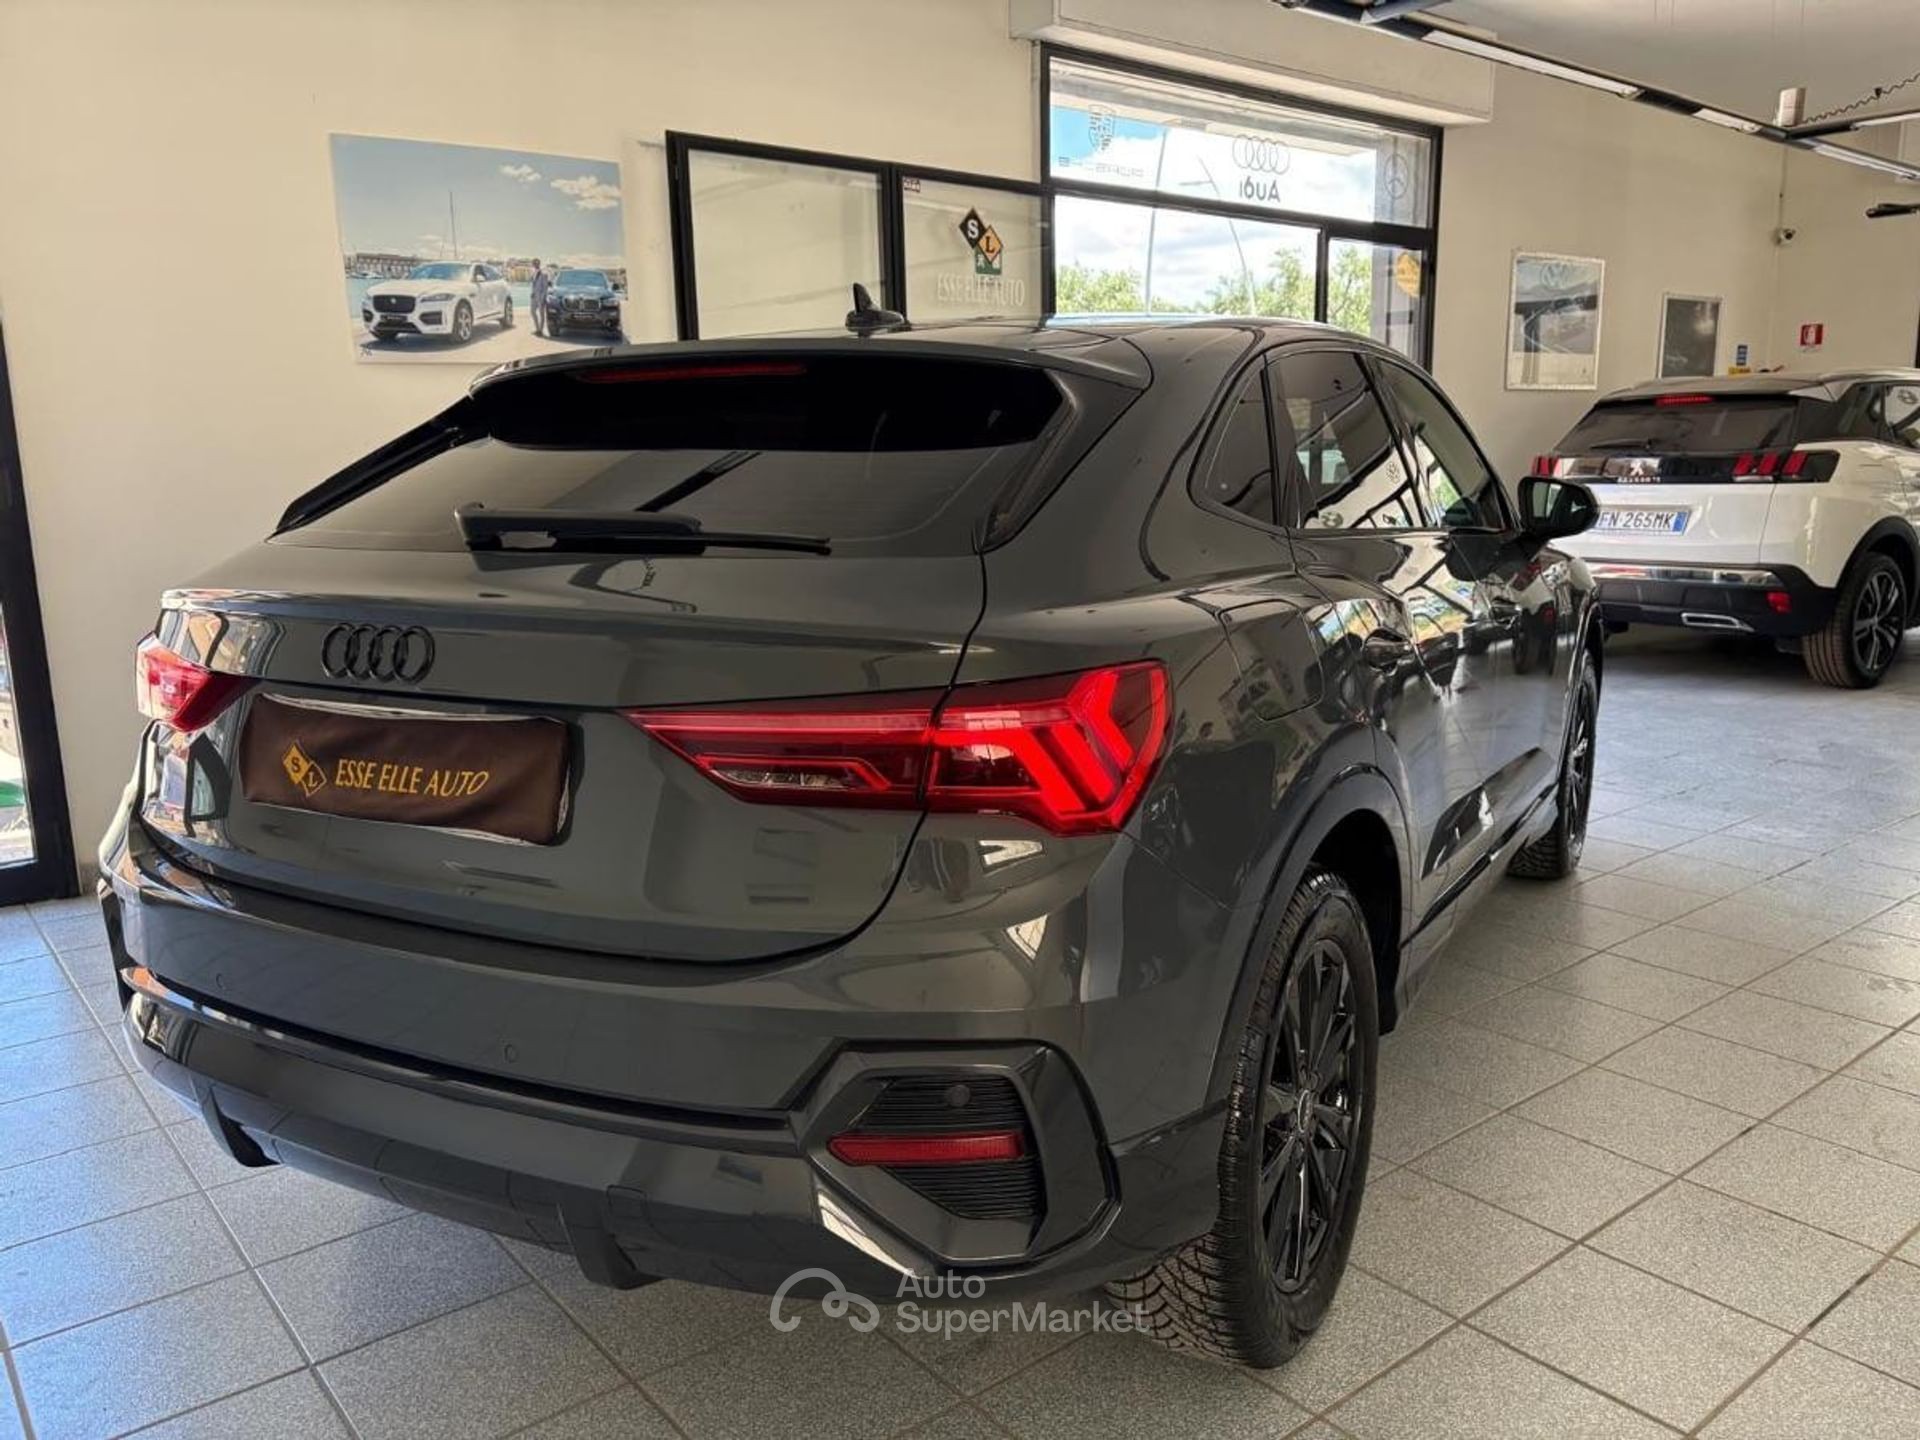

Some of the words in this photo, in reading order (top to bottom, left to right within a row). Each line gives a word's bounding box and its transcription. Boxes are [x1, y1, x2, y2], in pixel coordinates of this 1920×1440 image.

[966, 218, 980, 239] S
[984, 235, 997, 254] L
[1599, 511, 1620, 527] FN
[1622, 511, 1674, 529] 265MK
[291, 756, 301, 773] S
[308, 772, 318, 788] L
[335, 758, 378, 789] ESSE
[378, 763, 424, 794] ELLE
[423, 769, 490, 797] AUTO
